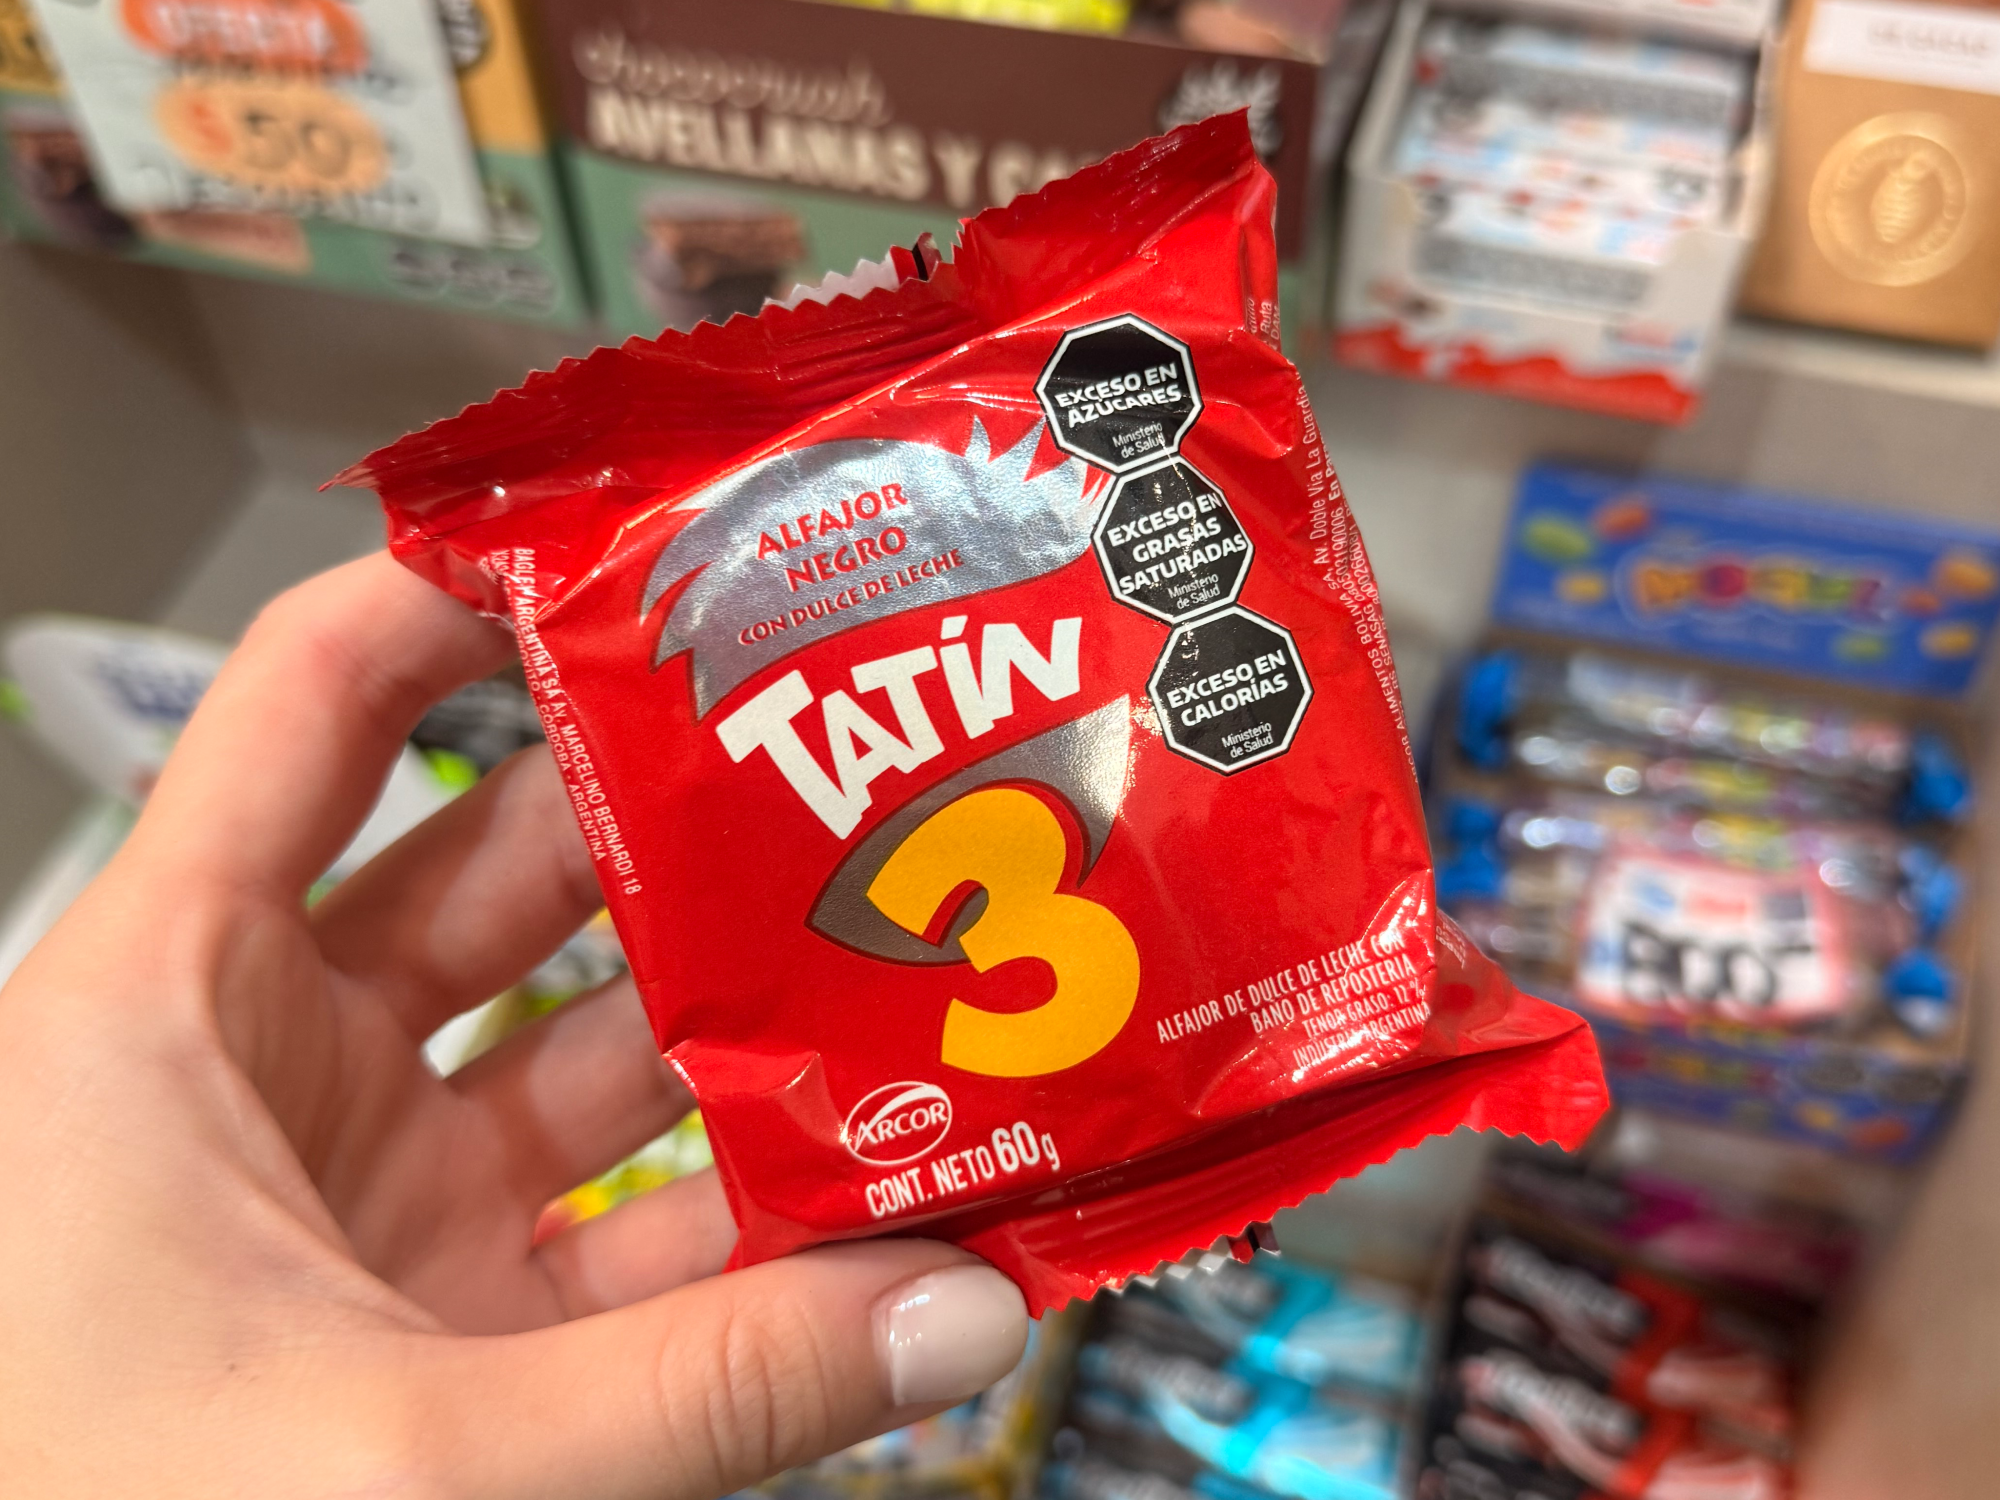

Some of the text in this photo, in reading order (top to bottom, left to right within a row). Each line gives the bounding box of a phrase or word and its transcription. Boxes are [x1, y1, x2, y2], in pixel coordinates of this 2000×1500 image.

[1054, 362, 1179, 409] EXCESO EN
[1112, 421, 1164, 448] Ministerio
[1296, 384, 1318, 445] Guardia
[1120, 433, 1166, 459] de Salud
[1306, 447, 1321, 469] La
[1307, 471, 1324, 497] Via
[1328, 479, 1341, 501] En
[757, 482, 908, 560] ALFAJOR
[1107, 492, 1223, 547] EXCESO EN
[1132, 516, 1222, 563] GRASAS
[1309, 499, 1327, 540] Doble
[785, 526, 907, 593] NEGRO
[1119, 533, 1248, 595] SATURADAS
[1168, 572, 1220, 599] Ministerio
[738, 548, 965, 646] CON DULCE DE LECHE
[1176, 584, 1221, 610] de Salud
[1340, 592, 1373, 645] BOLIVIA
[1363, 604, 1394, 666] SENASAG
[1166, 649, 1287, 709] EXCESO EN
[1181, 672, 1289, 727] CALORÍAS
[1367, 648, 1406, 730] ALIMENTOS
[514, 596, 556, 678] ARGENTINA
[561, 724, 606, 804] MARCELINO
[594, 805, 636, 877] BERNARDI
[622, 876, 643, 896] 18
[1221, 721, 1272, 748] Ministerio
[1230, 734, 1273, 759] de Salud
[568, 784, 607, 861] ARGENTINA
[866, 788, 1141, 1078] 3
[1156, 1000, 1223, 1044] ALFAJOR
[1224, 989, 1249, 1016] DE
[1247, 968, 1297, 1007] DULCE
[1297, 960, 1321, 987] DE
[1321, 940, 1370, 977] LECHE
[1296, 990, 1321, 1016] DE
[1320, 953, 1417, 1007] REPOSTERIA
[1301, 1011, 1347, 1040] TENOR
[1345, 993, 1393, 1023] GRASO:
[1362, 1001, 1432, 1042] ARGENTINA
[855, 1098, 949, 1153] ARCOR
[865, 1167, 934, 1218] CONT.
[930, 1145, 996, 1192] NETO
[990, 1121, 1041, 1173] 60
